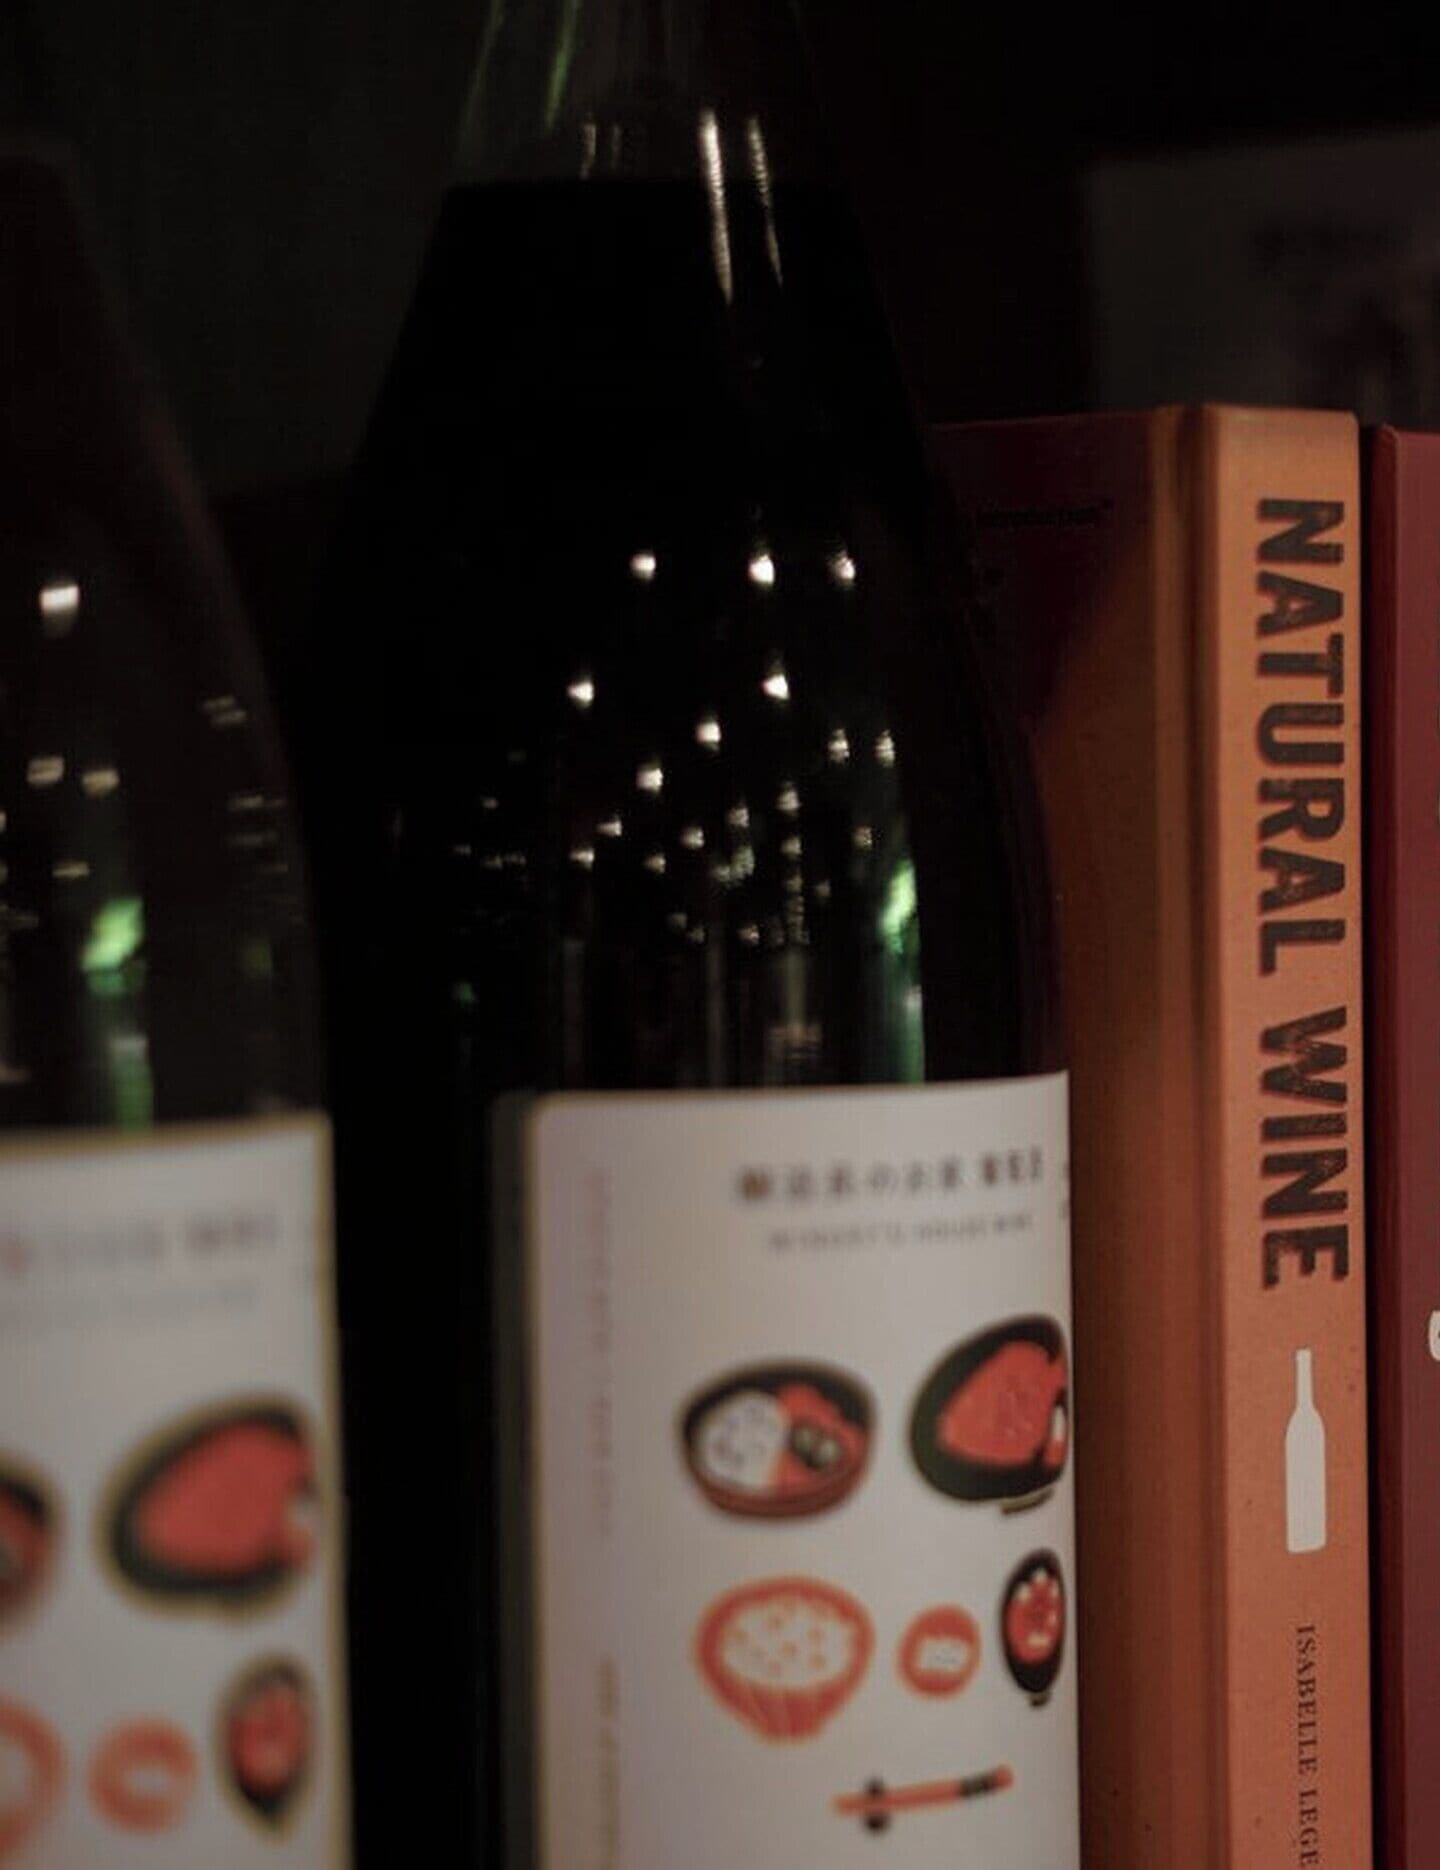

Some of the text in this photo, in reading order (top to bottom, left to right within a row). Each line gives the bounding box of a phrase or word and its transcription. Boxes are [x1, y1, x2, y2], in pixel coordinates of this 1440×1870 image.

[1256, 498, 1350, 1290] NATURAL WINE
[1297, 1623, 1318, 1778] ISABELLE
